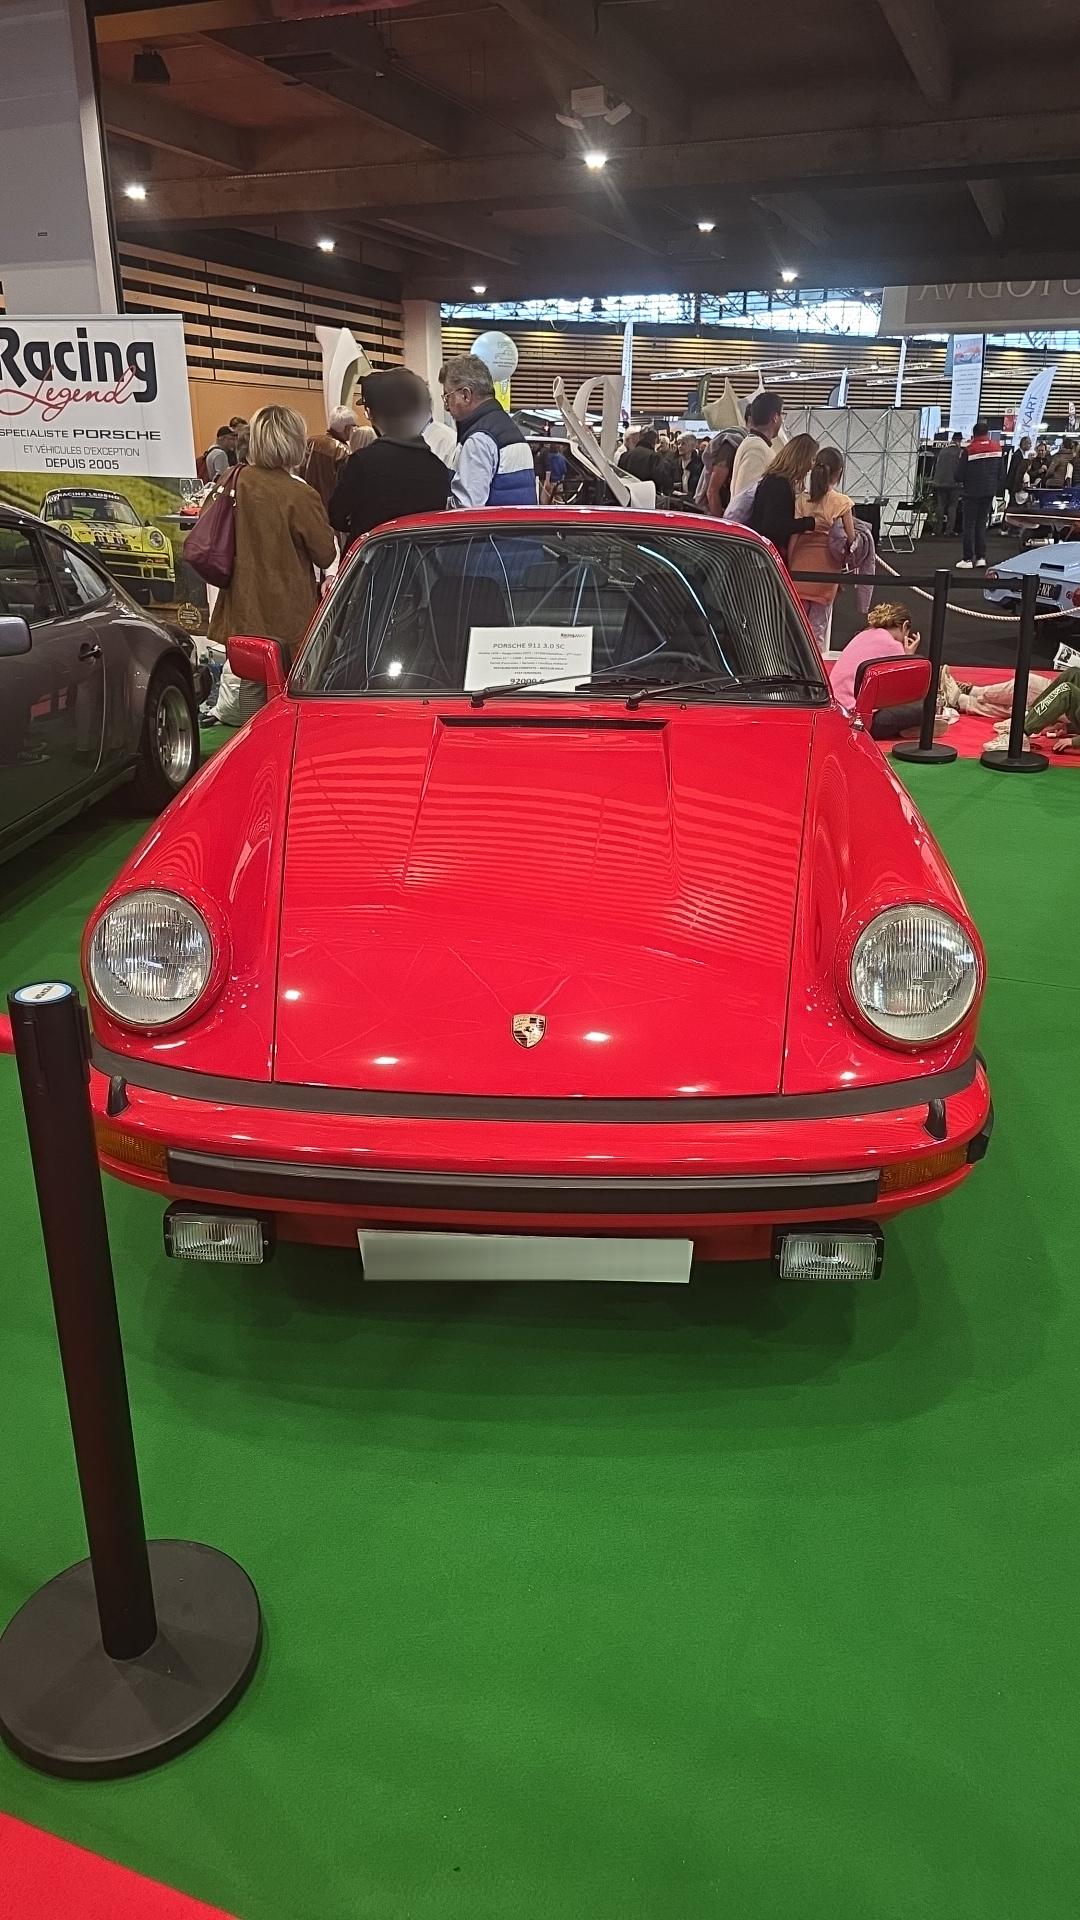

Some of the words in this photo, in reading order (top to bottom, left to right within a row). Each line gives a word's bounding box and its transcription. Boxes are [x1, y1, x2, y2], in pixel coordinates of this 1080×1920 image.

[0, 327, 158, 403] Racing
[0, 364, 137, 422] Legend
[73, 429, 161, 441] PORSCHE
[23, 444, 33, 454] ET
[35, 444, 82, 455] VÉHICULES
[83, 446, 140, 457] D'EXCEPTION
[45, 457, 86, 469] DEPUIS
[88, 459, 120, 470] 2005
